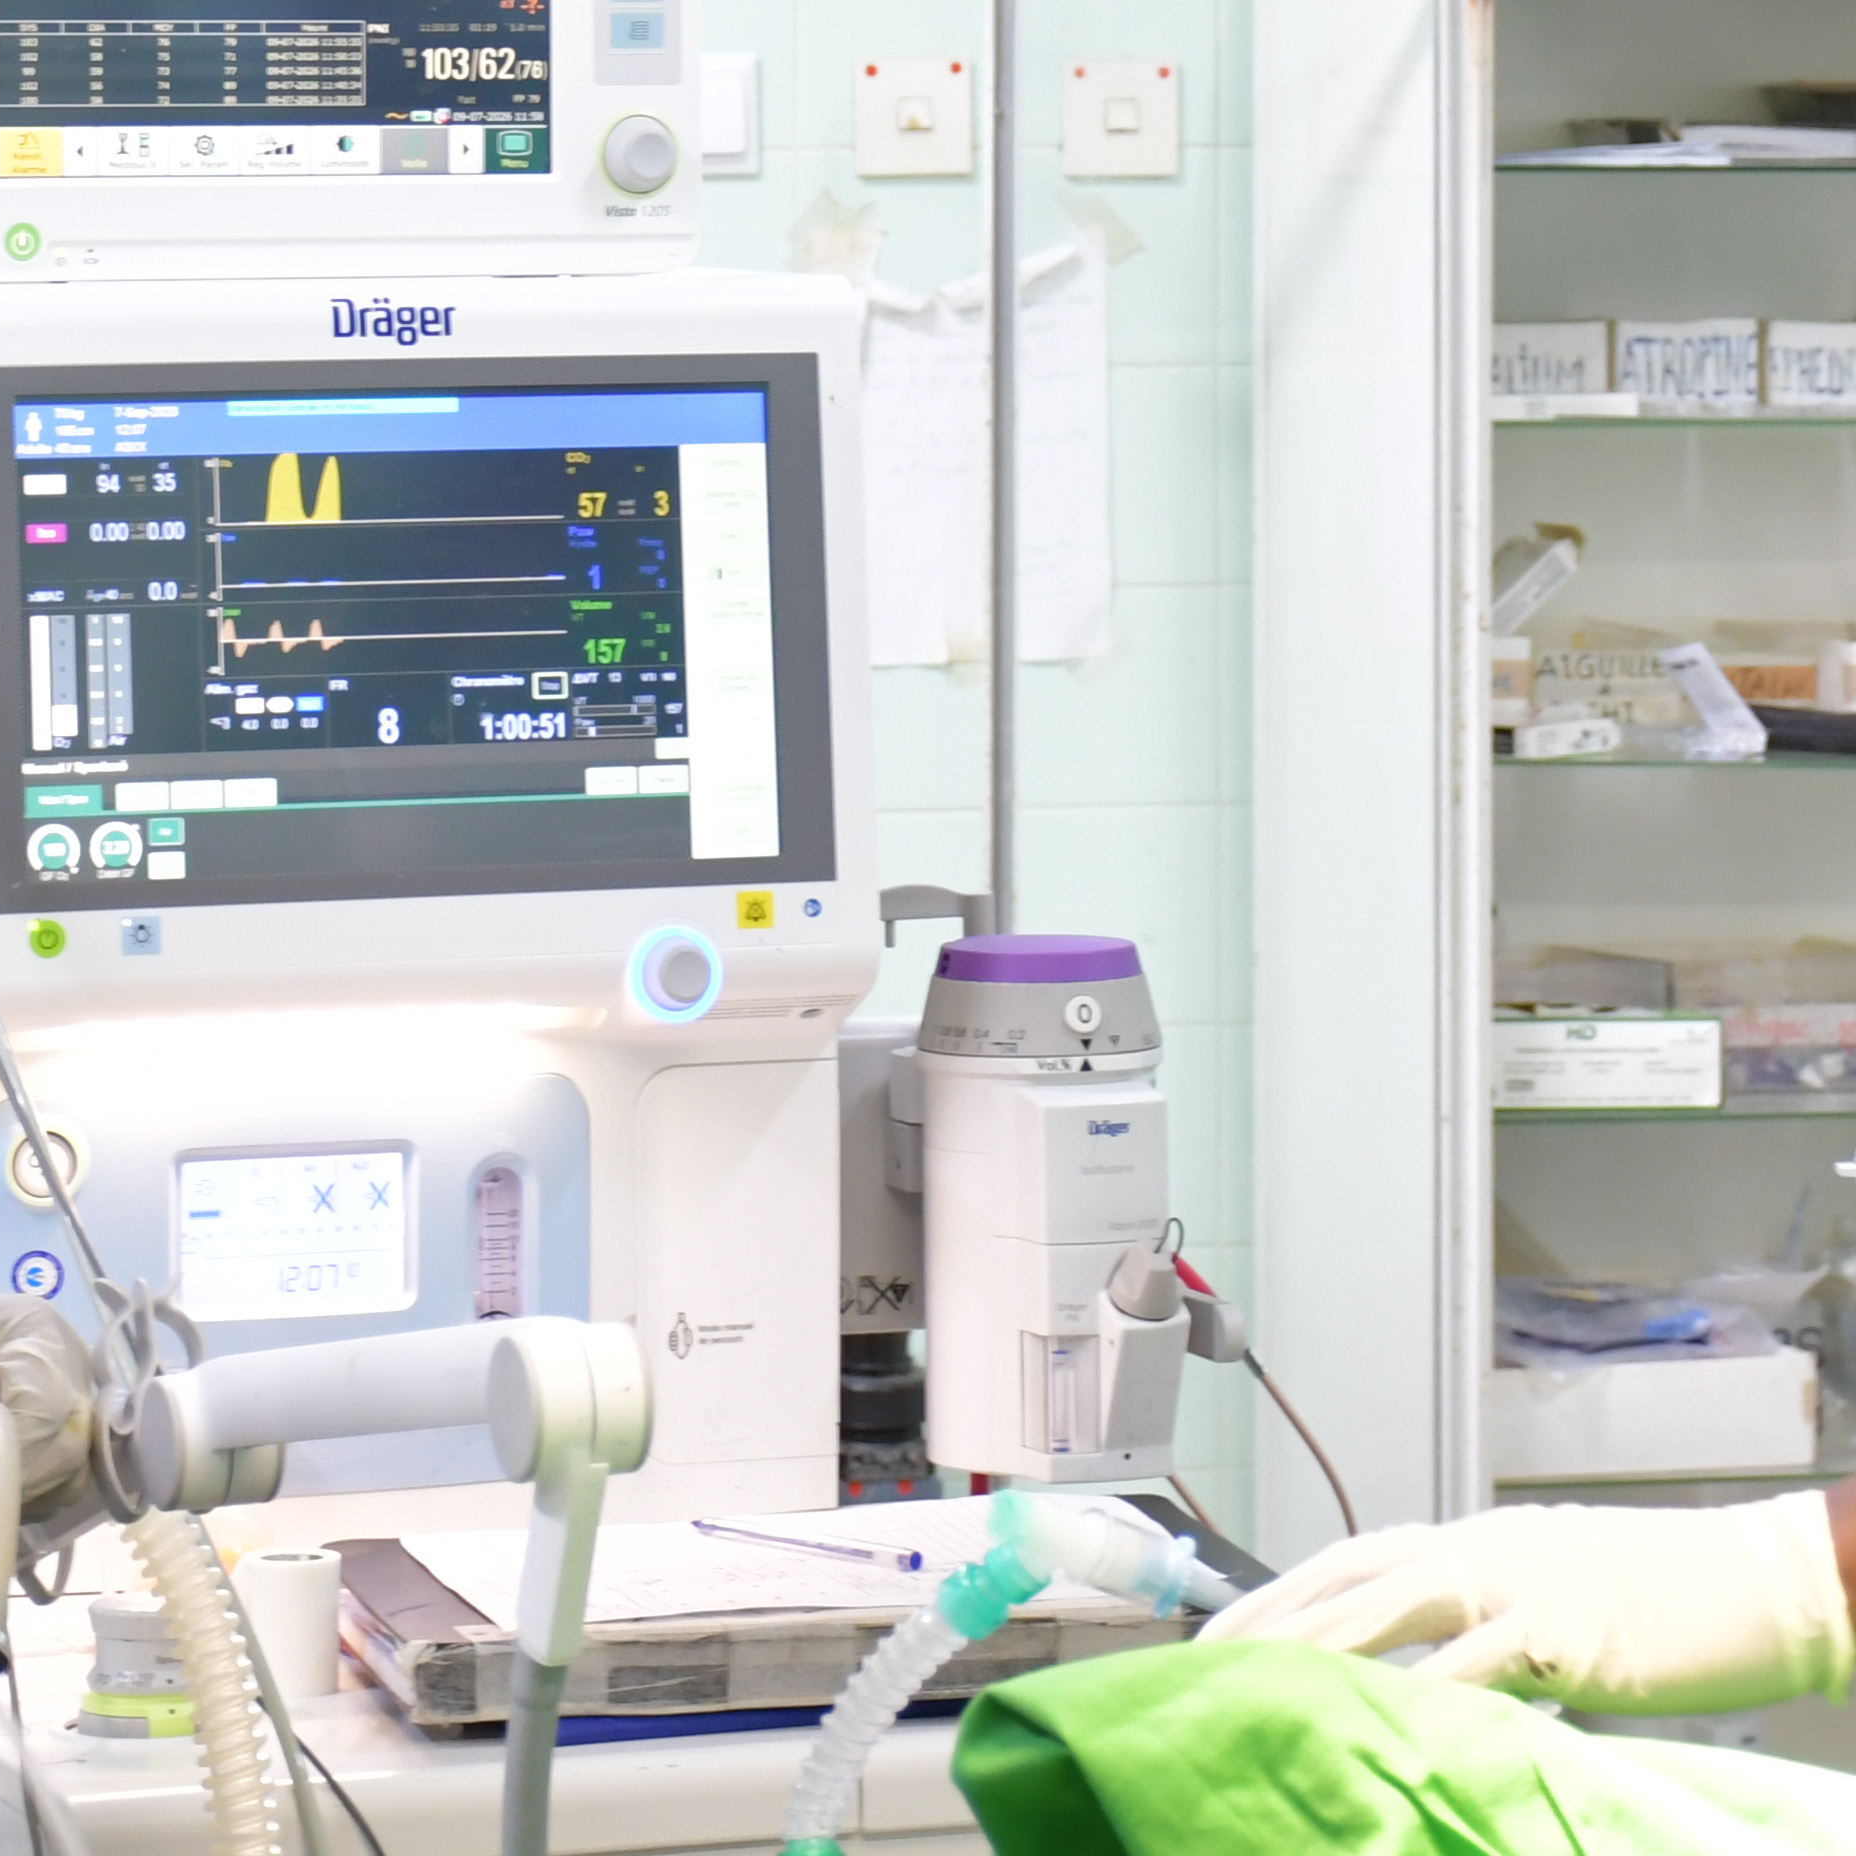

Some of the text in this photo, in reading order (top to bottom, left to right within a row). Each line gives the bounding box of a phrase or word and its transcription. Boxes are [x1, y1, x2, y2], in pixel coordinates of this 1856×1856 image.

[366, 23, 390, 34] PNI
[604, 205, 637, 217] Vista
[330, 297, 458, 347] Dräger
[95, 474, 121, 494] 94
[152, 472, 177, 492] 35
[577, 490, 670, 518] 57 3
[89, 521, 186, 542] 0.00 0.00
[587, 564, 603, 591] 1
[147, 581, 178, 601] 0.0
[569, 599, 613, 611] Volume
[582, 637, 627, 665] 157
[377, 706, 400, 745] 8
[479, 711, 568, 741] 1:00:51
[1077, 1003, 1094, 1024] 0
[1088, 1120, 1131, 1137] Dräger
[278, 1262, 339, 1293] 12:07
